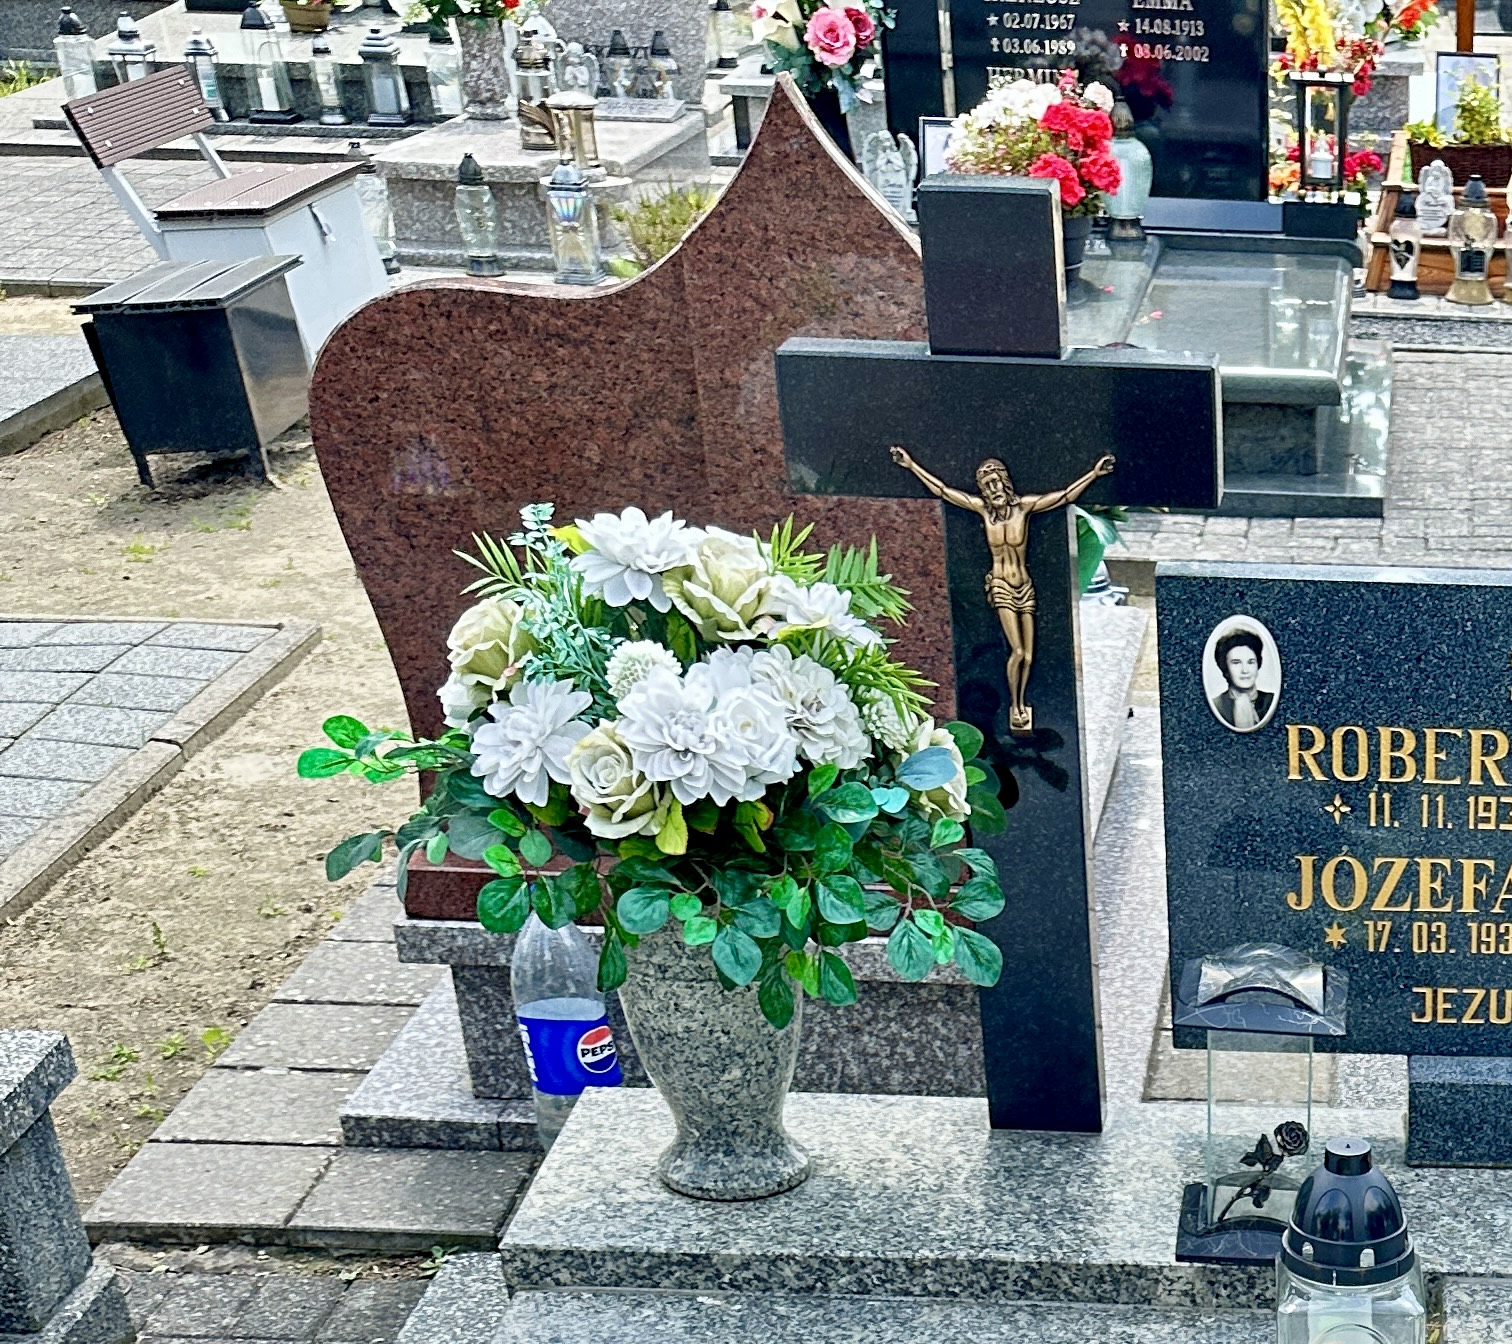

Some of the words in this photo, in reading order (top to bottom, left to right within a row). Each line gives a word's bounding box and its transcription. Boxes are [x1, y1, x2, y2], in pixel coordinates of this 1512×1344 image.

[1002, 12, 1077, 30] 02.07.1967
[1135, 18, 1206, 37] 14.08.1913
[580, 1041, 615, 1058] PEPS
